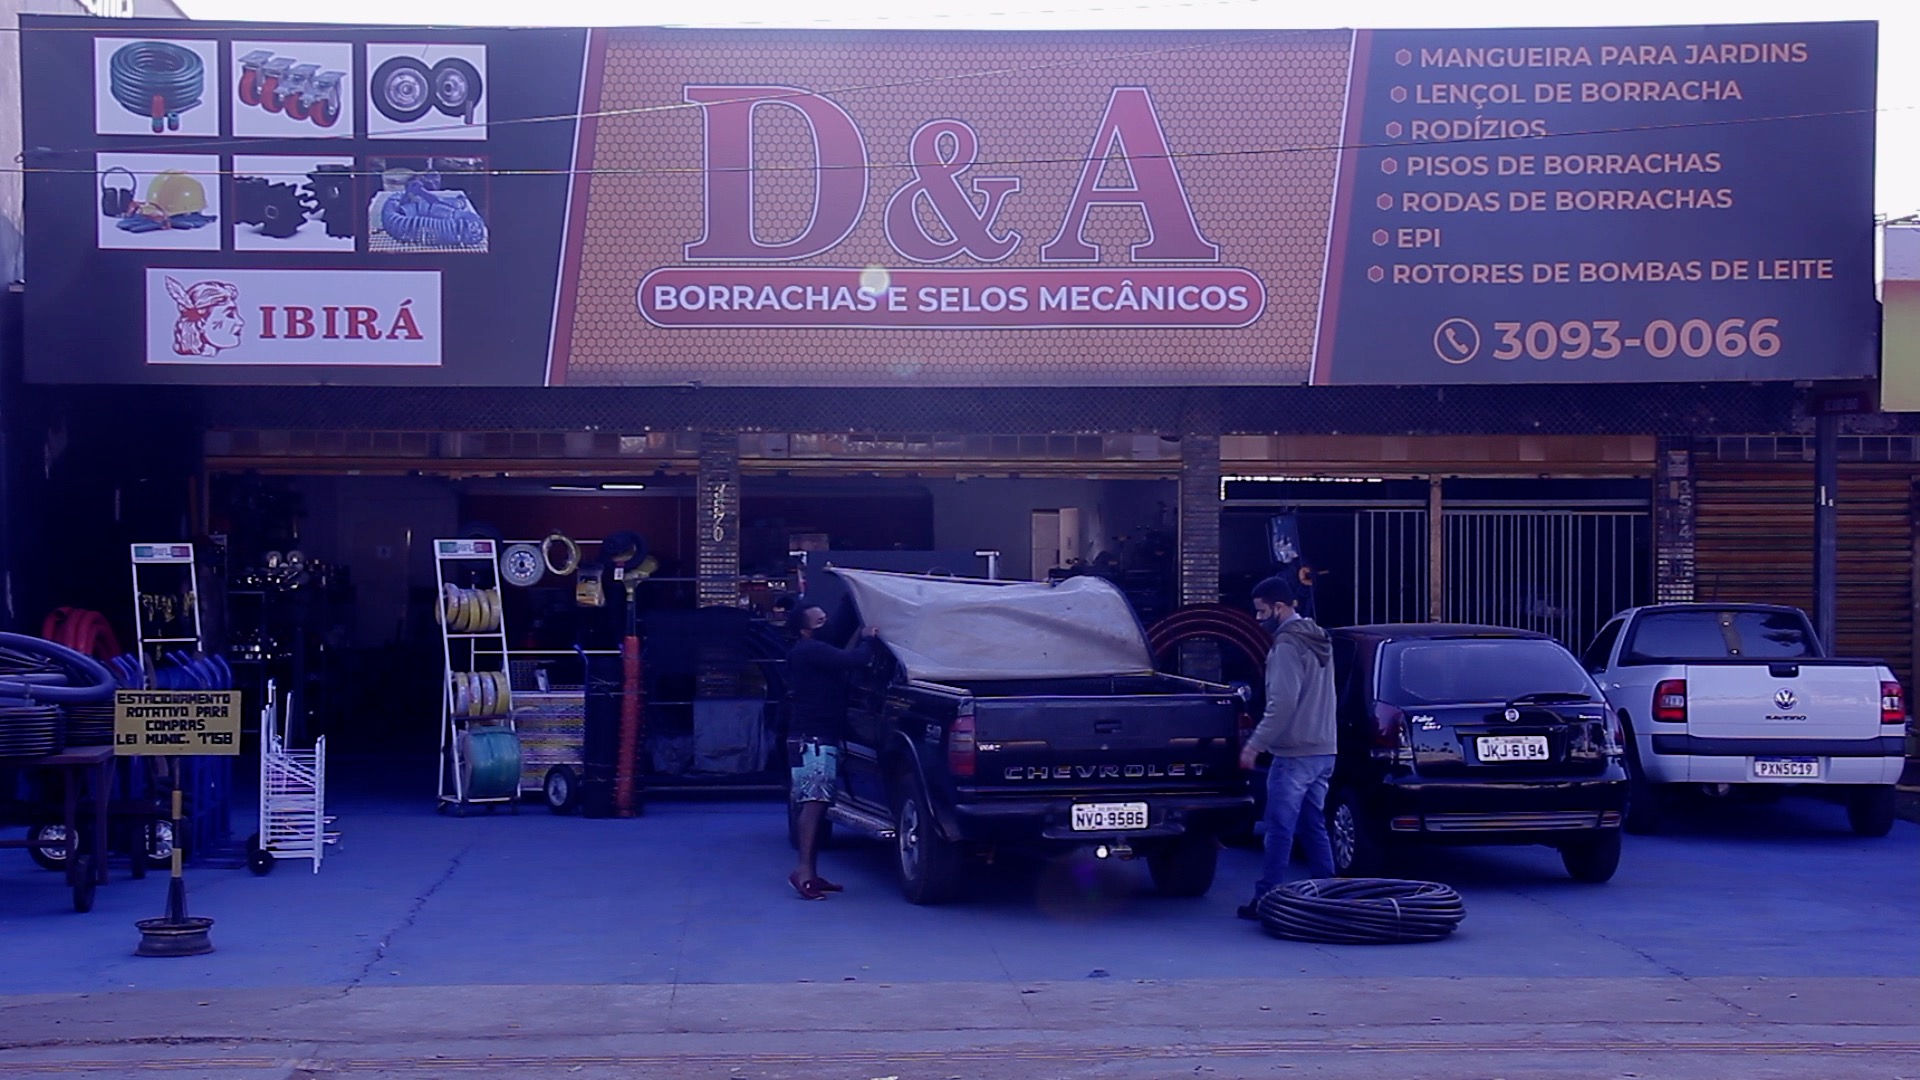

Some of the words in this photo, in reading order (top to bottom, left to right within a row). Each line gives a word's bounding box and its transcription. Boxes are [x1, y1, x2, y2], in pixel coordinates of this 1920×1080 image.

[1420, 47, 1592, 68] MANGUEIRA
[1601, 45, 1678, 66] PARA
[1684, 43, 1808, 65] JARDINS
[1416, 82, 1526, 109] LENÇOL
[1534, 82, 1572, 103] DE
[1582, 80, 1742, 102] BORRACHA
[1411, 114, 1546, 140] RODÍZIOS
[683, 84, 1220, 264] D&A
[1407, 155, 1489, 176] PISOS
[1498, 154, 1535, 175] DE
[1544, 152, 1721, 175] BORRACHAS
[1402, 191, 1500, 212] RODAS
[1509, 190, 1546, 211] DE
[1556, 189, 1732, 211] BORRACHAS
[1398, 228, 1441, 248] EPI
[1393, 263, 1523, 284] ROTORES
[1533, 263, 1570, 283] DE
[1579, 260, 1702, 283] BOMBAS
[1711, 260, 1748, 281] DE
[1758, 259, 1834, 280] LEITE
[653, 285, 877, 314] BORRACHAS
[887, 287, 908, 313] E
[918, 285, 1029, 314] SELOS
[1039, 280, 1249, 314] MECÂNICOS
[259, 299, 424, 341] IBIRÁ
[1492, 318, 1781, 361] 3093-0066
[117, 694, 230, 705] ESTACIONAMENTO
[126, 706, 189, 718] ROTATIVO
[195, 705, 228, 718] PARA
[146, 718, 206, 731] COMPRAS
[116, 733, 138, 745] LEI
[146, 733, 191, 745] MUNIC.
[1482, 744, 1545, 760] JKJ-6194
[1004, 763, 1210, 780] CHEVROLET
[1760, 763, 1813, 775] PXN5C19
